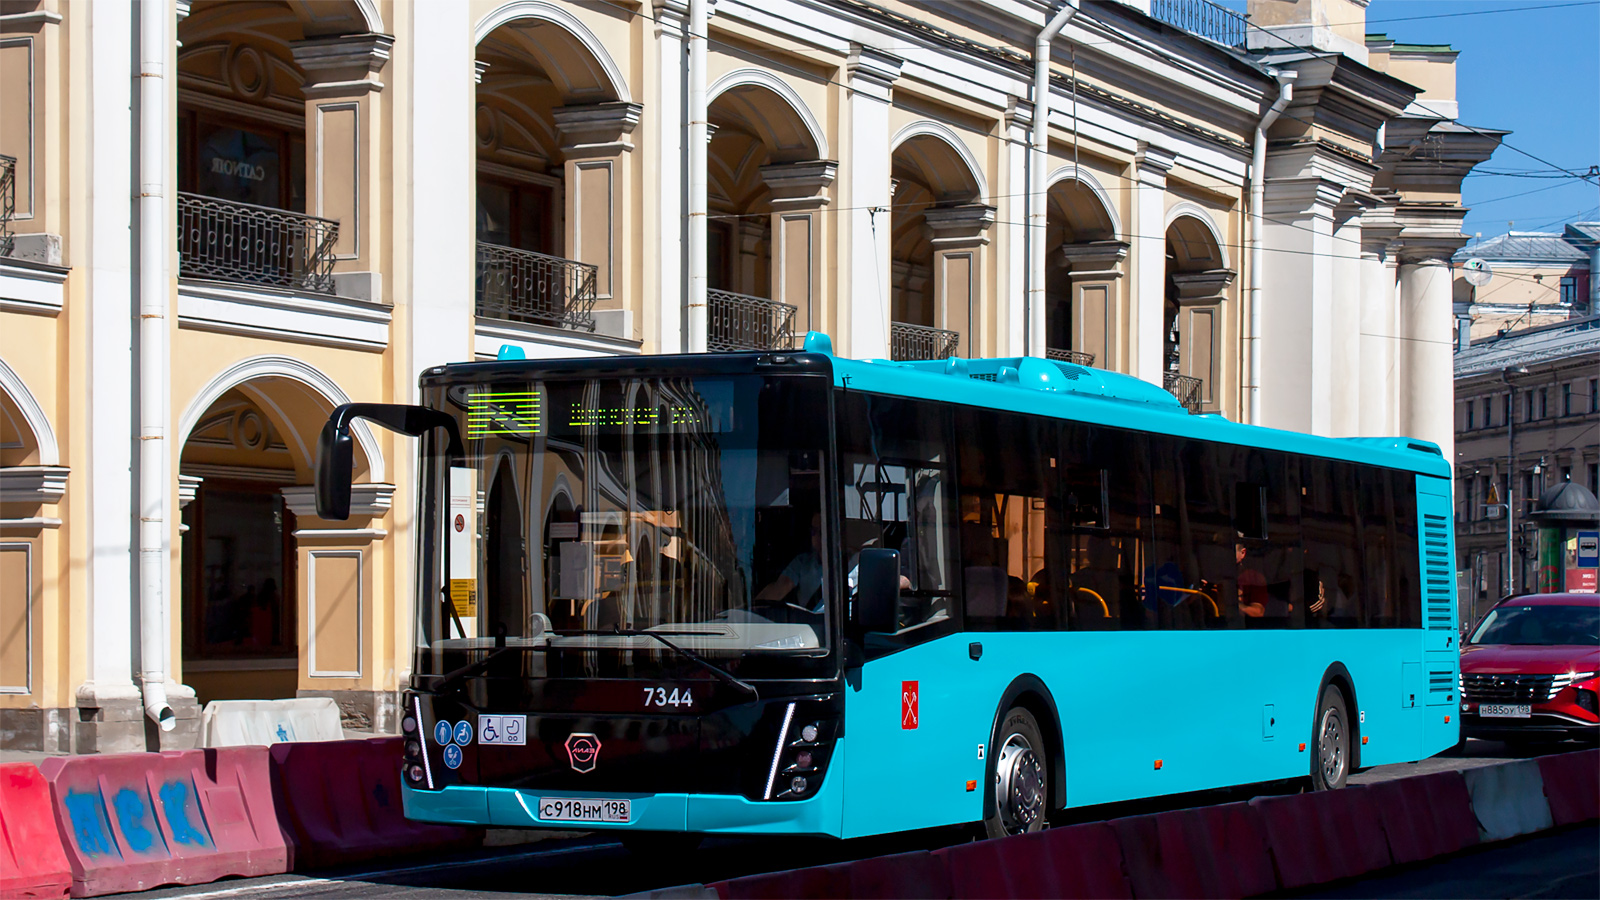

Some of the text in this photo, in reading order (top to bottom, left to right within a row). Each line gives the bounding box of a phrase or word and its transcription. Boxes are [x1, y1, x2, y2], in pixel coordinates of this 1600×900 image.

[643, 687, 693, 707] 7344
[544, 801, 626, 818] С918НМ 198
